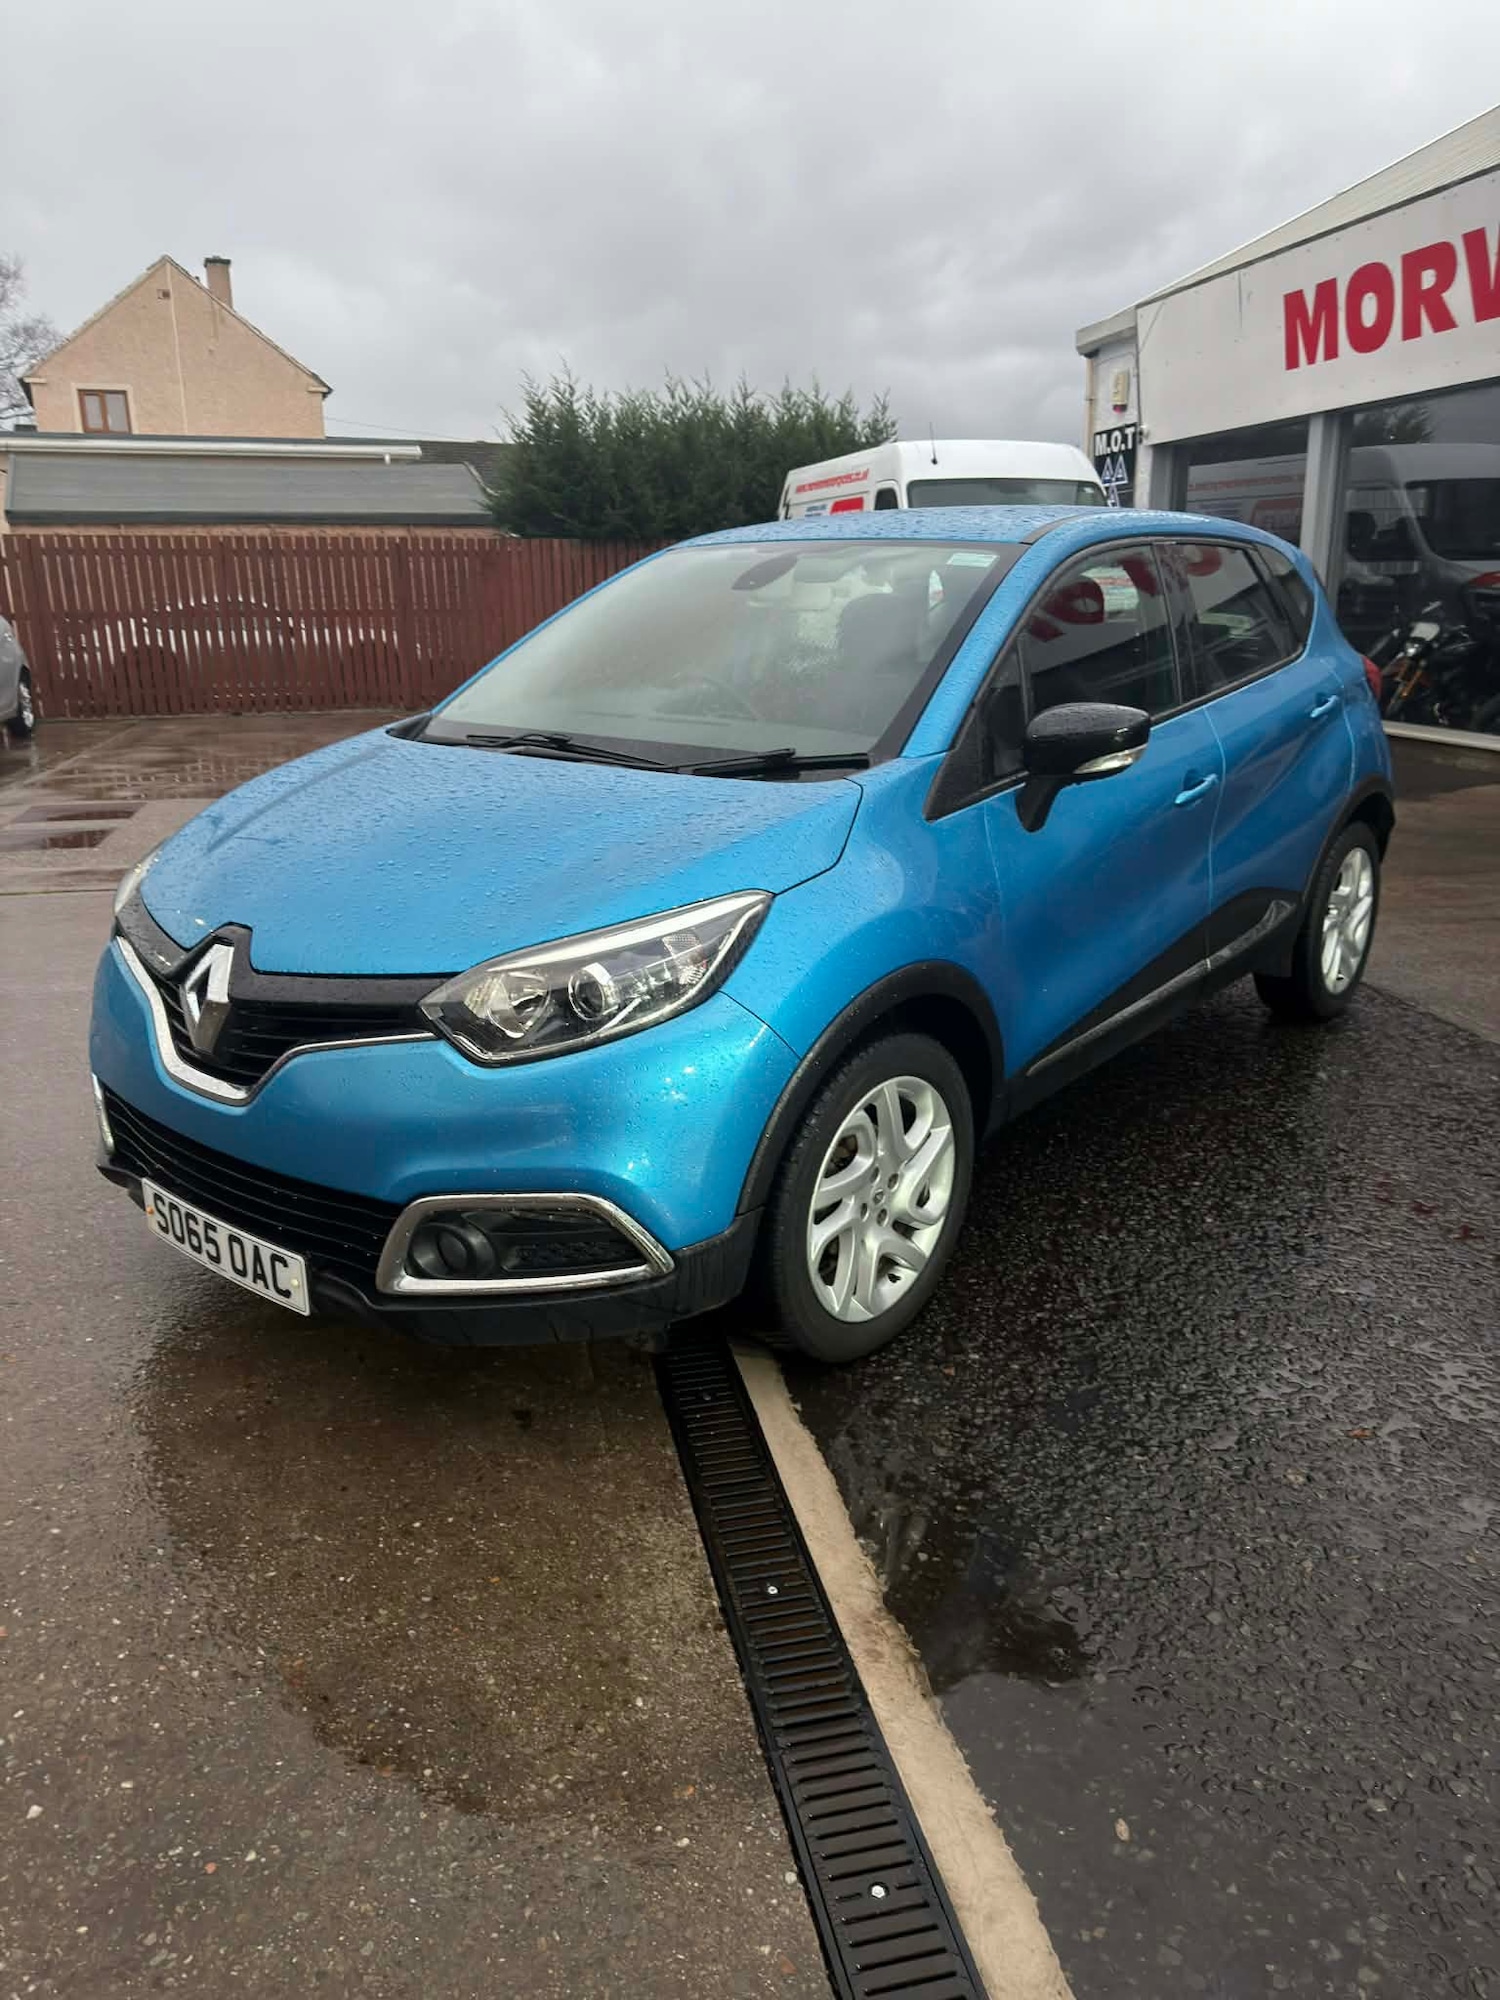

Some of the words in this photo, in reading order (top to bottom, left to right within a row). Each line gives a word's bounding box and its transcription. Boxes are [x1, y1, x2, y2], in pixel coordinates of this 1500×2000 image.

[1094, 426, 1136, 456] M.O.T
[153, 1192, 221, 1265] SO65
[228, 1233, 292, 1299] OAC
